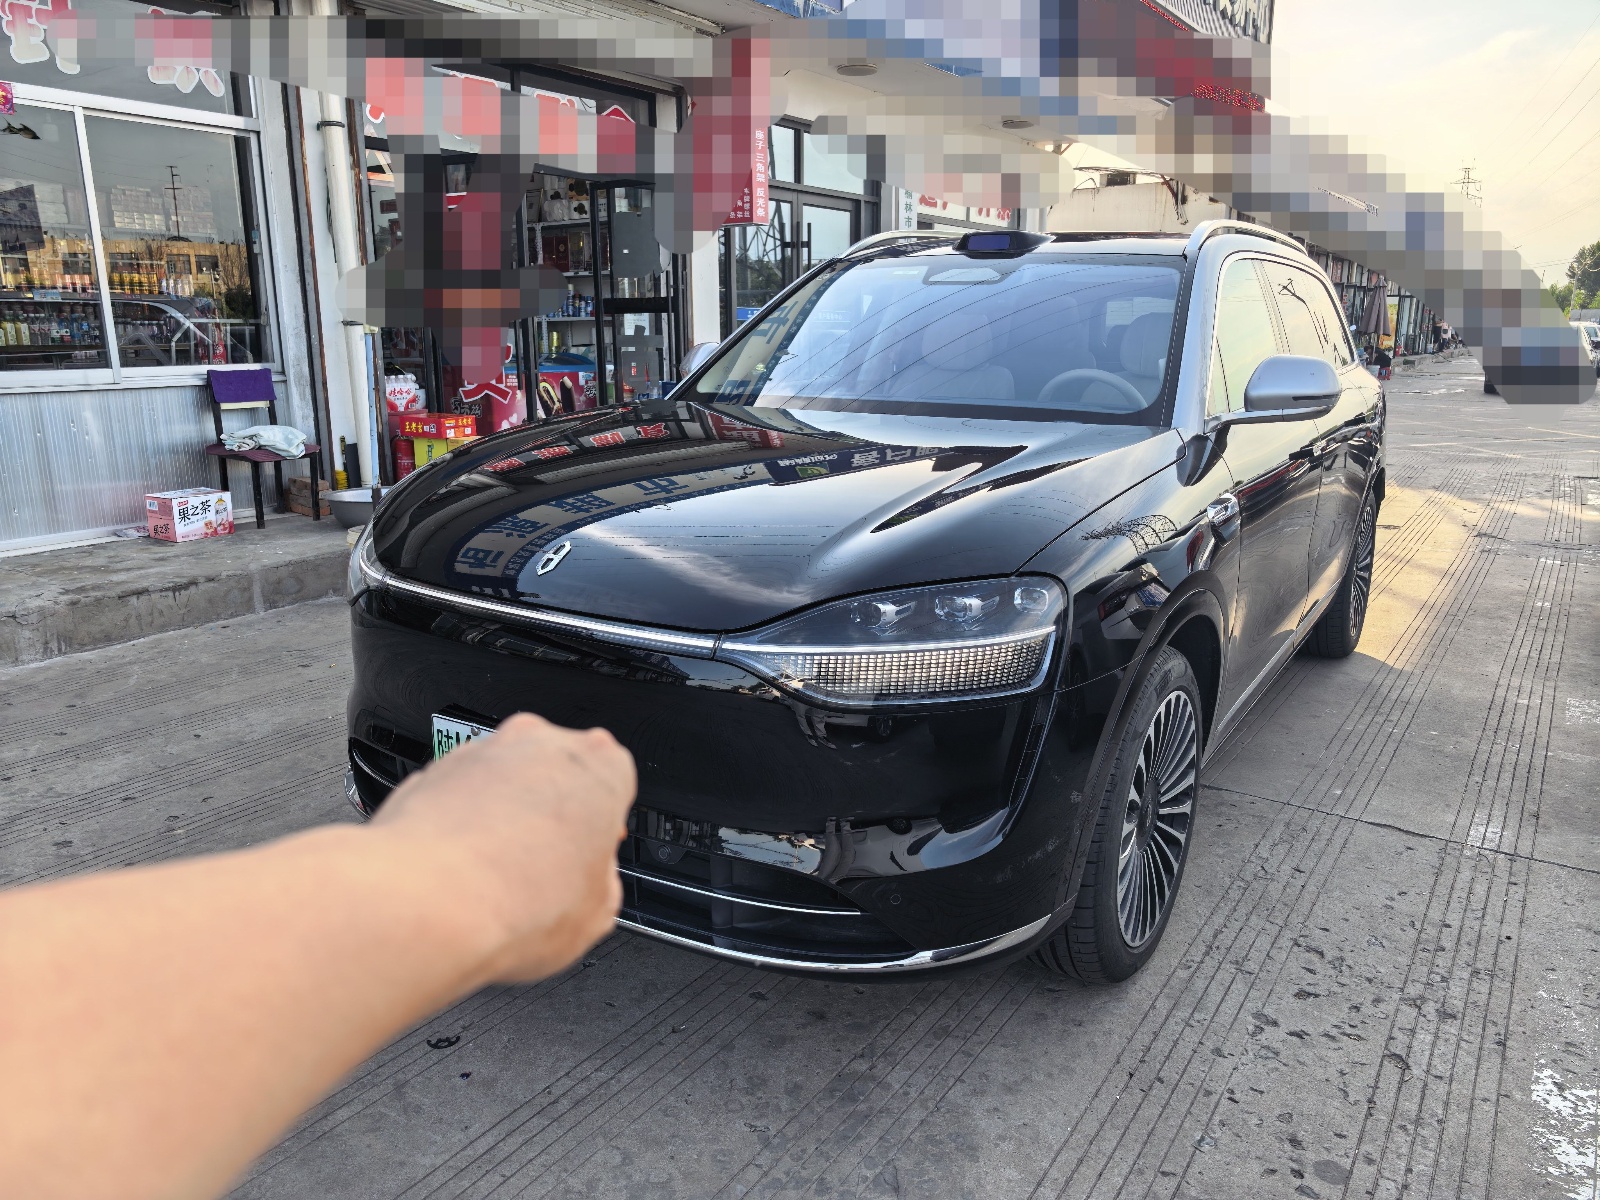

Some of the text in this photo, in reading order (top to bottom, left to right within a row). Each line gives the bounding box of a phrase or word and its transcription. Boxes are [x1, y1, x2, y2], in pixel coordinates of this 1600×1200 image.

[756, 188, 766, 217] 反光条
[388, 387, 412, 398] 娃哈哈
[405, 421, 424, 434] 王老吉
[458, 417, 473, 427] 王老吉
[178, 499, 212, 524] 果之茶
[153, 523, 170, 537] 果之茶
